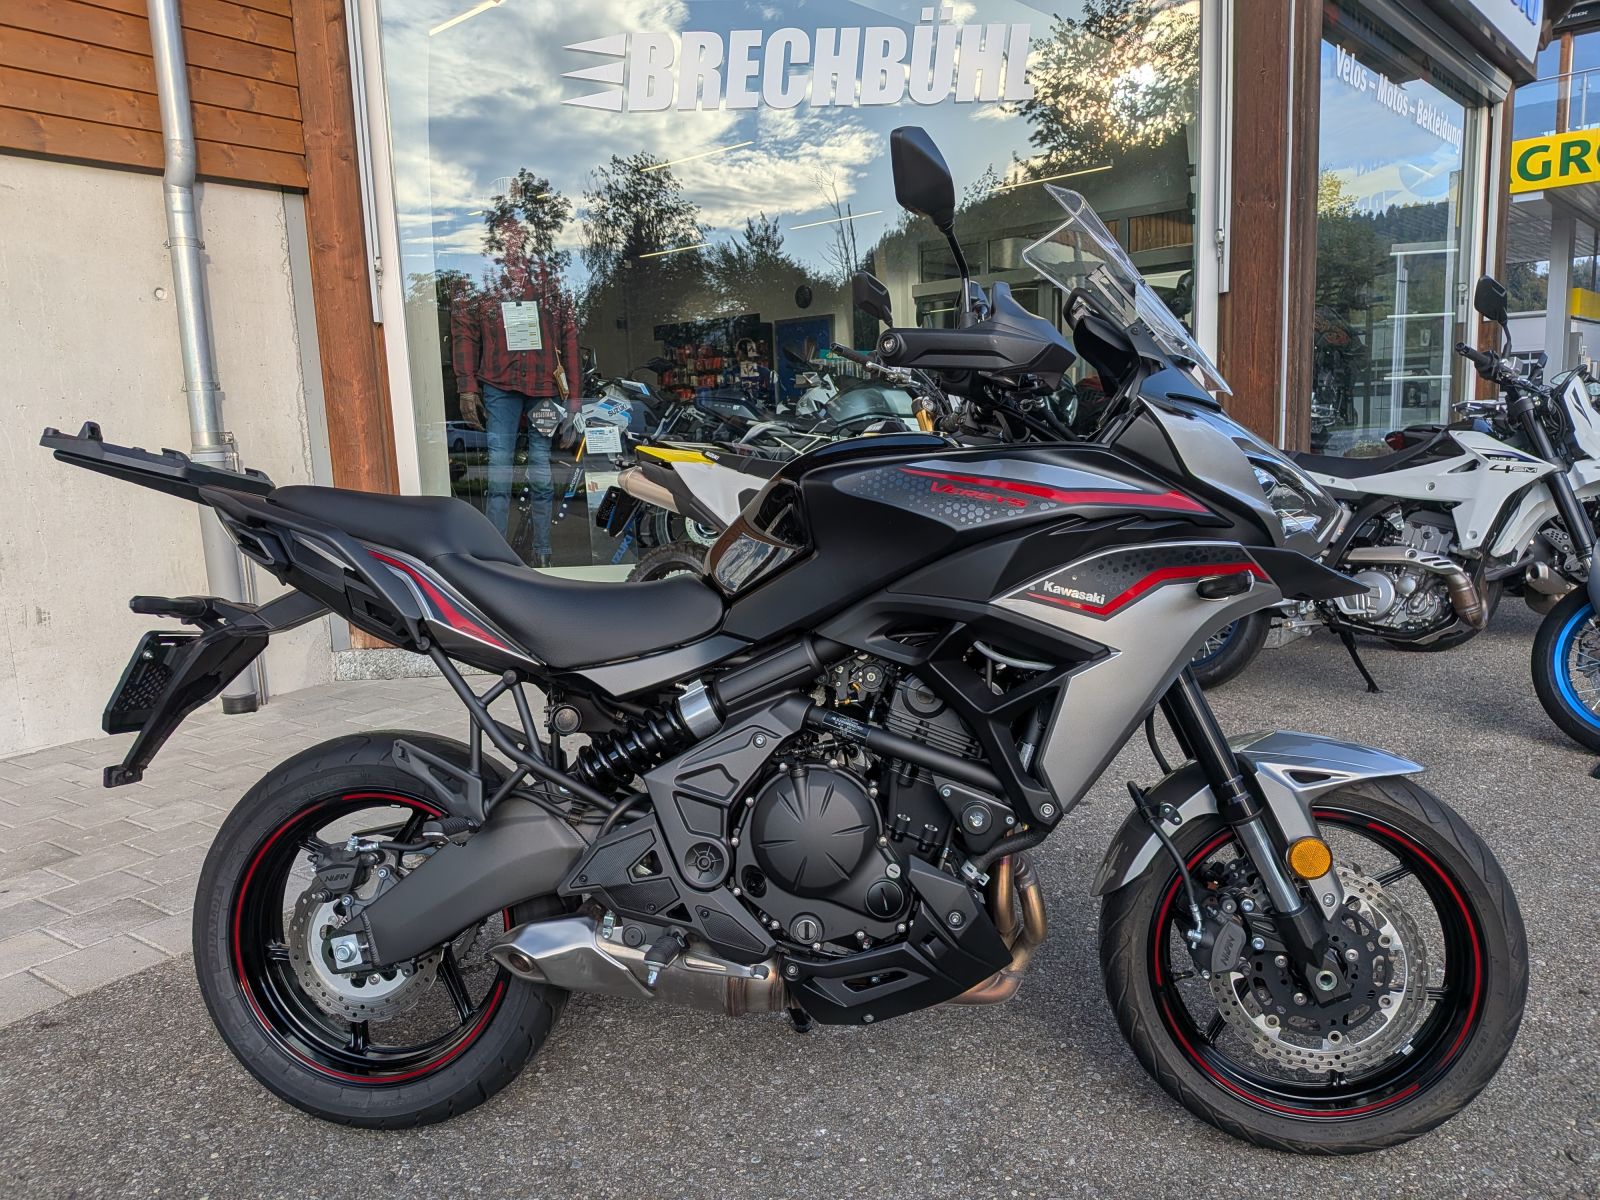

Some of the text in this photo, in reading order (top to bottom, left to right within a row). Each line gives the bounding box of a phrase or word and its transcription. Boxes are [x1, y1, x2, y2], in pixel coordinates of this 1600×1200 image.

[628, 7, 1035, 112] BRECHBÜHL
[1336, 44, 1368, 92] Velos
[1377, 72, 1408, 117] Motos
[1416, 98, 1462, 154] Bekleidung
[1043, 580, 1106, 605] Kawasaki
